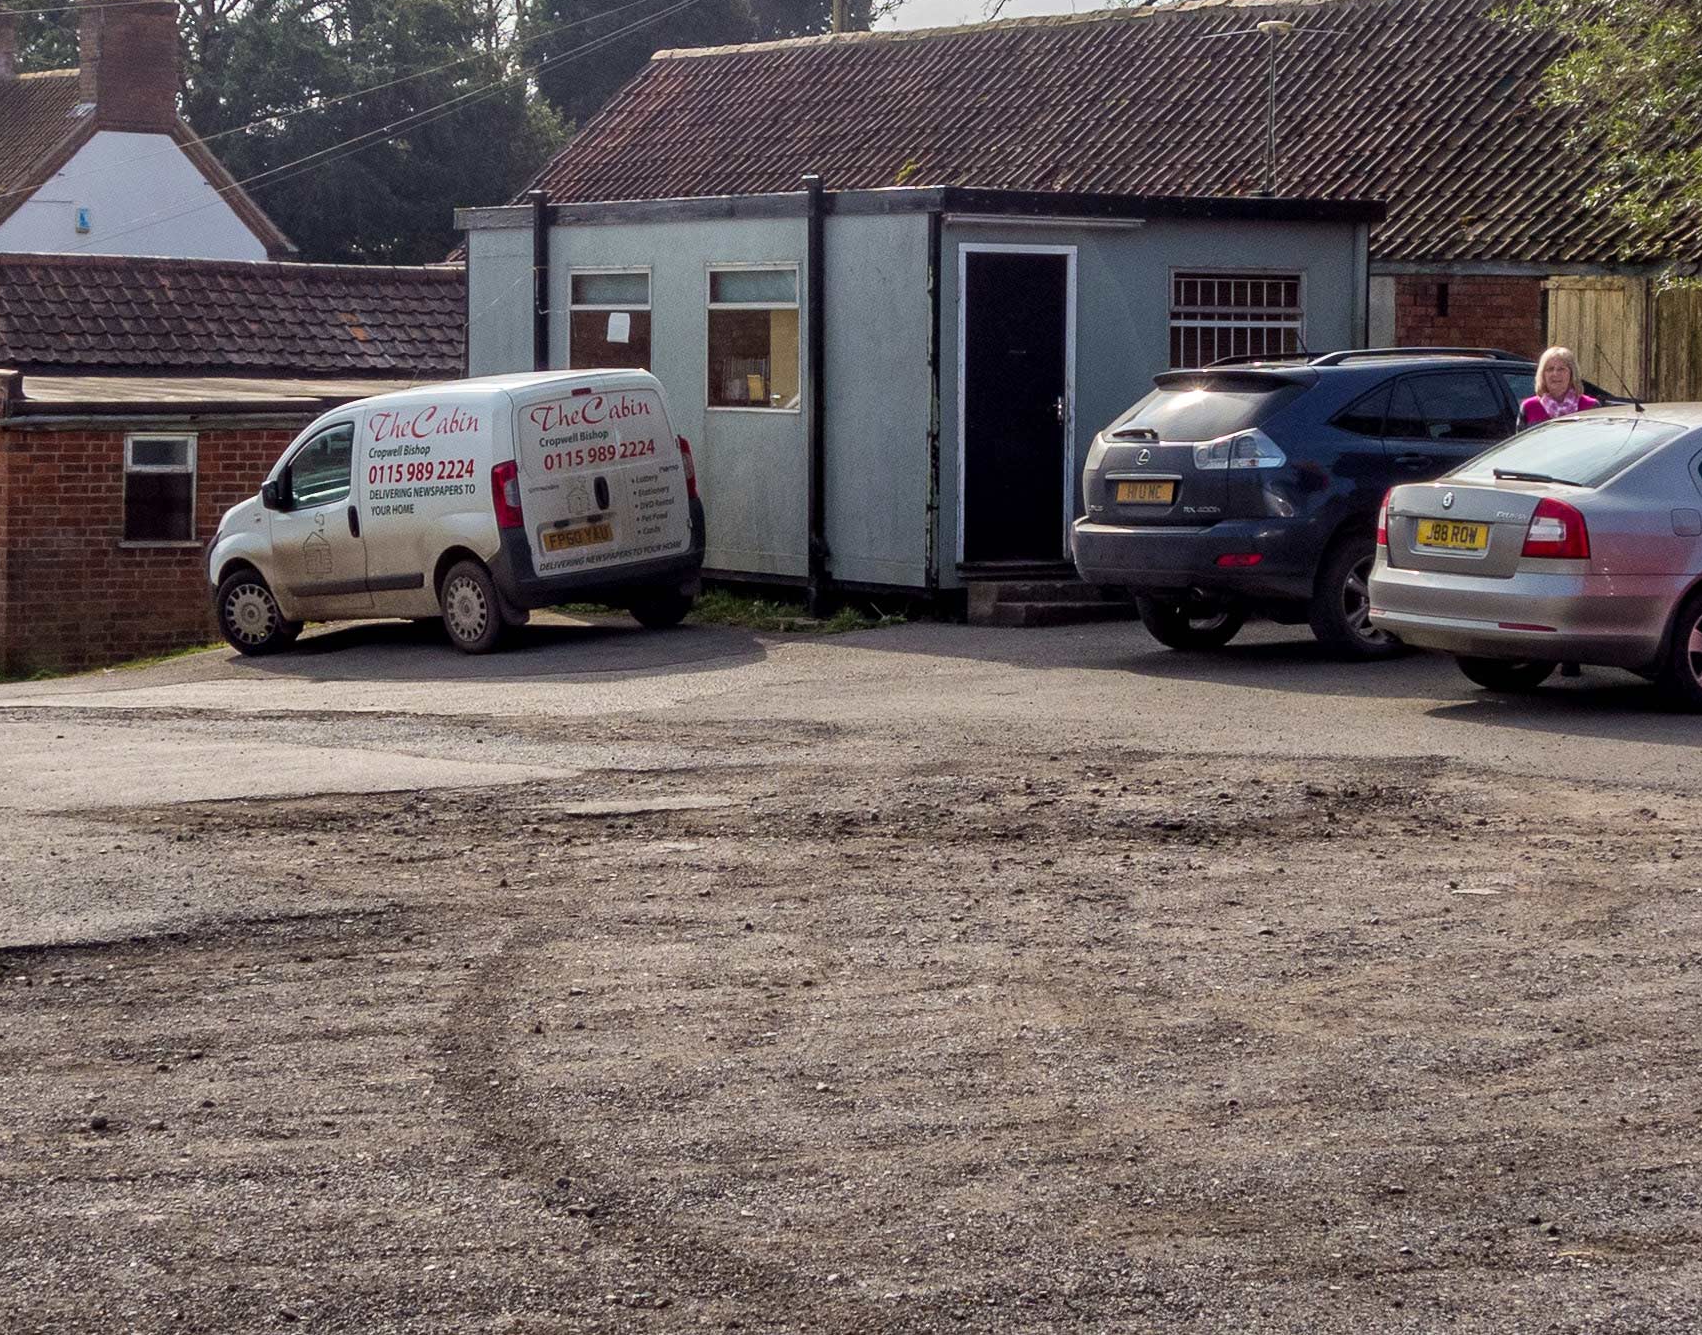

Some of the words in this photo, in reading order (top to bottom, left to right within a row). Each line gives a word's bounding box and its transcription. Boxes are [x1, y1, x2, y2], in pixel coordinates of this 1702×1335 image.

[531, 405, 578, 431] The
[582, 396, 650, 424] Cabin
[369, 412, 411, 441] The
[411, 406, 478, 438] Cabin
[539, 433, 579, 447] Cropwell
[580, 430, 609, 442] Bishop
[369, 445, 403, 460] Cropwell
[404, 443, 430, 457] Bishop
[544, 449, 584, 470] 0115
[587, 446, 616, 463] 989
[619, 439, 655, 458] 2224
[369, 464, 403, 484] 0115
[407, 462, 434, 482] 989
[437, 459, 474, 480] 2224
[636, 475, 658, 484] Lottery
[369, 488, 412, 500] DELIVERING
[413, 485, 463, 497] NEWSPAPERS
[465, 484, 476, 495] TO
[639, 487, 669, 497] Stationery
[371, 505, 391, 516] YOUR
[392, 504, 414, 514] HOME
[640, 501, 654, 510] DVD
[656, 497, 674, 506] Rental
[653, 511, 668, 520] Food
[1425, 524, 1448, 541] J88
[1451, 526, 1478, 544] ROW
[539, 558, 584, 571] DELIVERING
[585, 549, 632, 564] NEWSPAPERS
[633, 547, 643, 556] TO
[643, 544, 661, 554] YOUR
[663, 540, 683, 550] HOME
